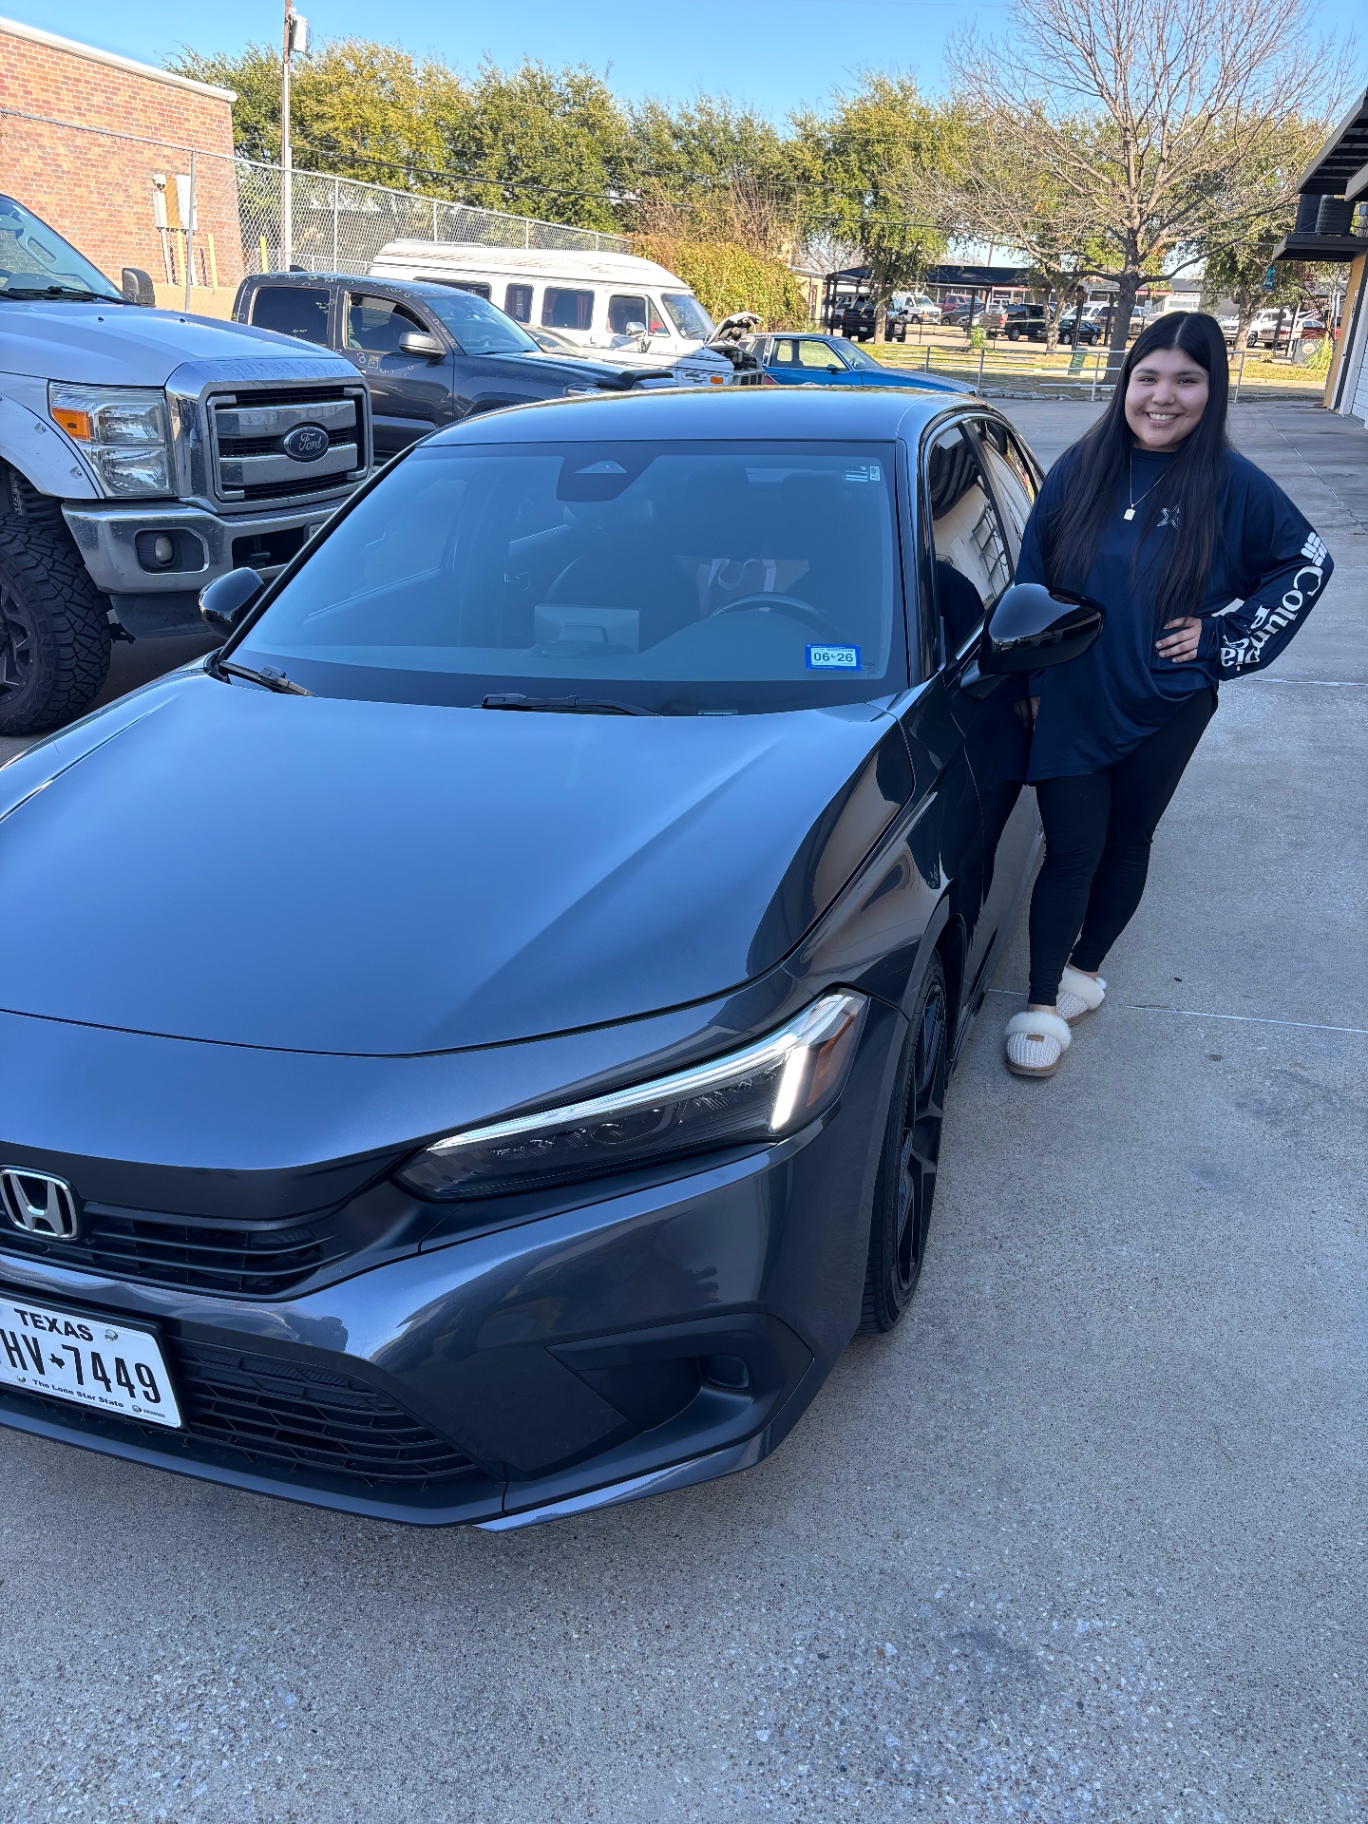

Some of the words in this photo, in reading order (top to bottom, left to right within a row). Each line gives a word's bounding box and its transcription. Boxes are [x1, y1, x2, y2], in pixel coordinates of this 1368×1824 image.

[298, 432, 322, 451] Ford
[813, 652, 830, 661] 06
[837, 653, 853, 662] 26
[13, 1308, 94, 1342] TEXAS
[0, 1328, 46, 1376] HV
[61, 1343, 162, 1404] 7449
[32, 1378, 50, 1389] The
[51, 1383, 75, 1396] Lone
[76, 1390, 97, 1401] Star
[98, 1396, 125, 1408] State
